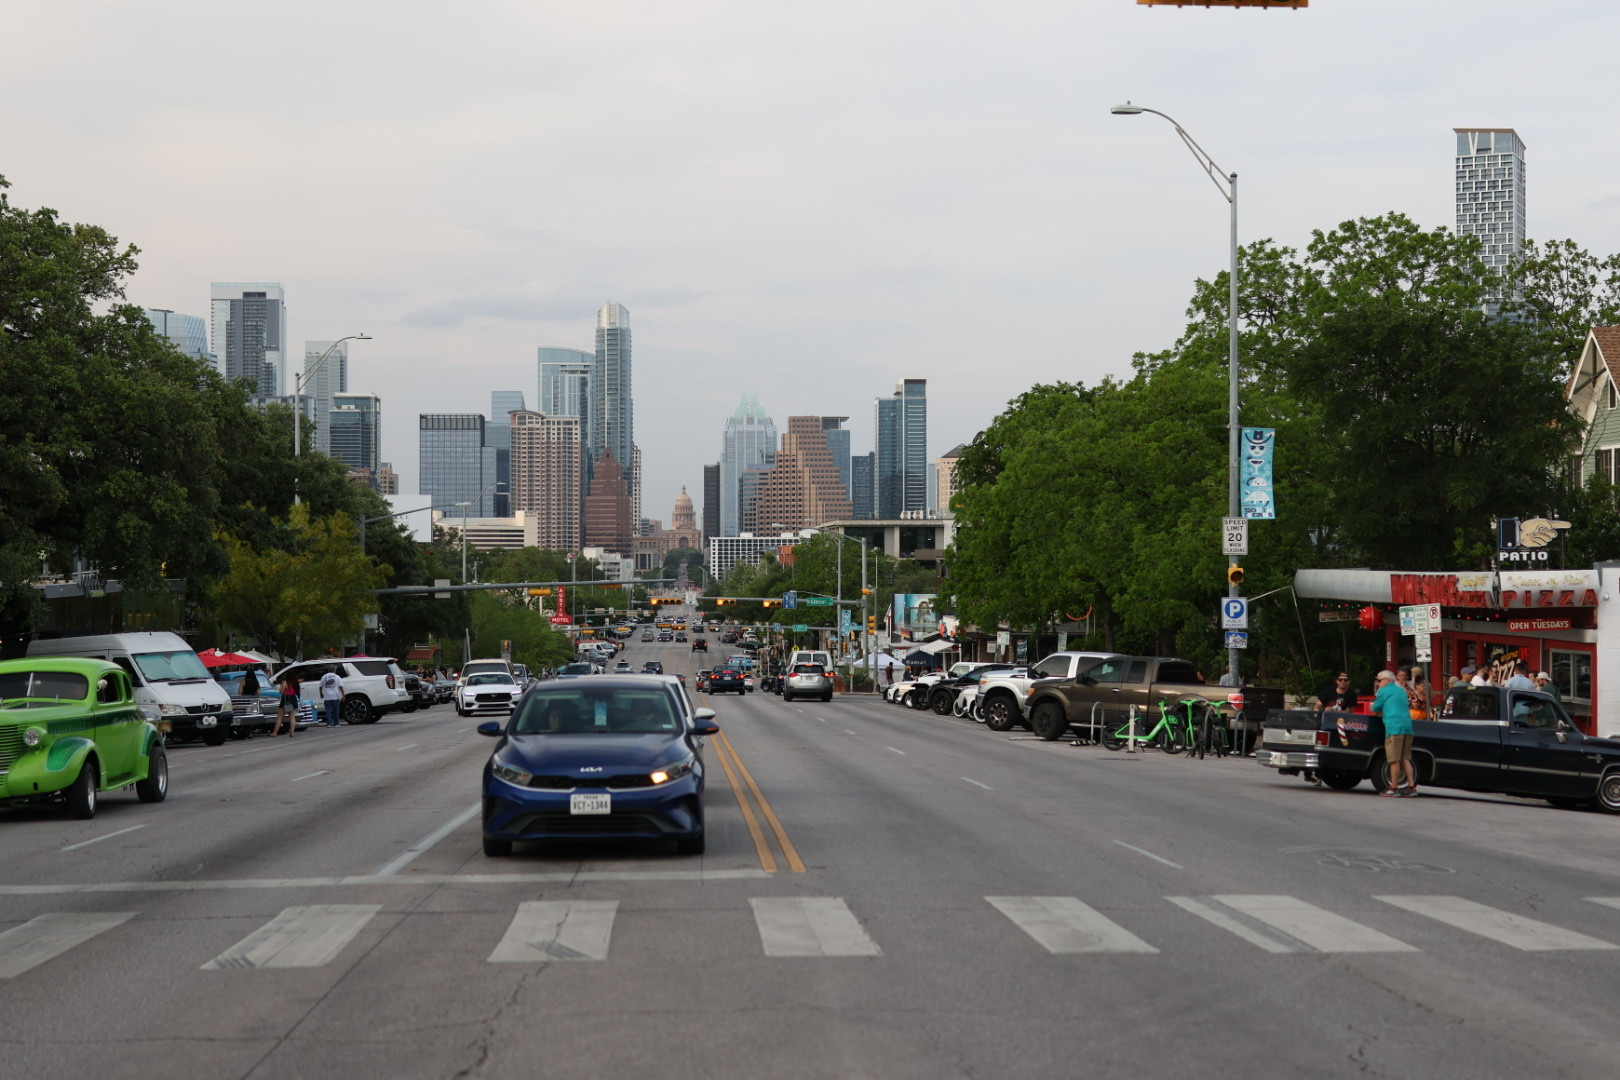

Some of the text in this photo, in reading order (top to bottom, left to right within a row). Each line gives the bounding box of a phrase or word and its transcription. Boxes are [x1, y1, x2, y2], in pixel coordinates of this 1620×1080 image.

[1227, 532, 1243, 542] 20
[1499, 551, 1549, 561] PATIO
[1501, 588, 1599, 608] PIZZA
[1510, 620, 1569, 630] OPEN TUESDAYS
